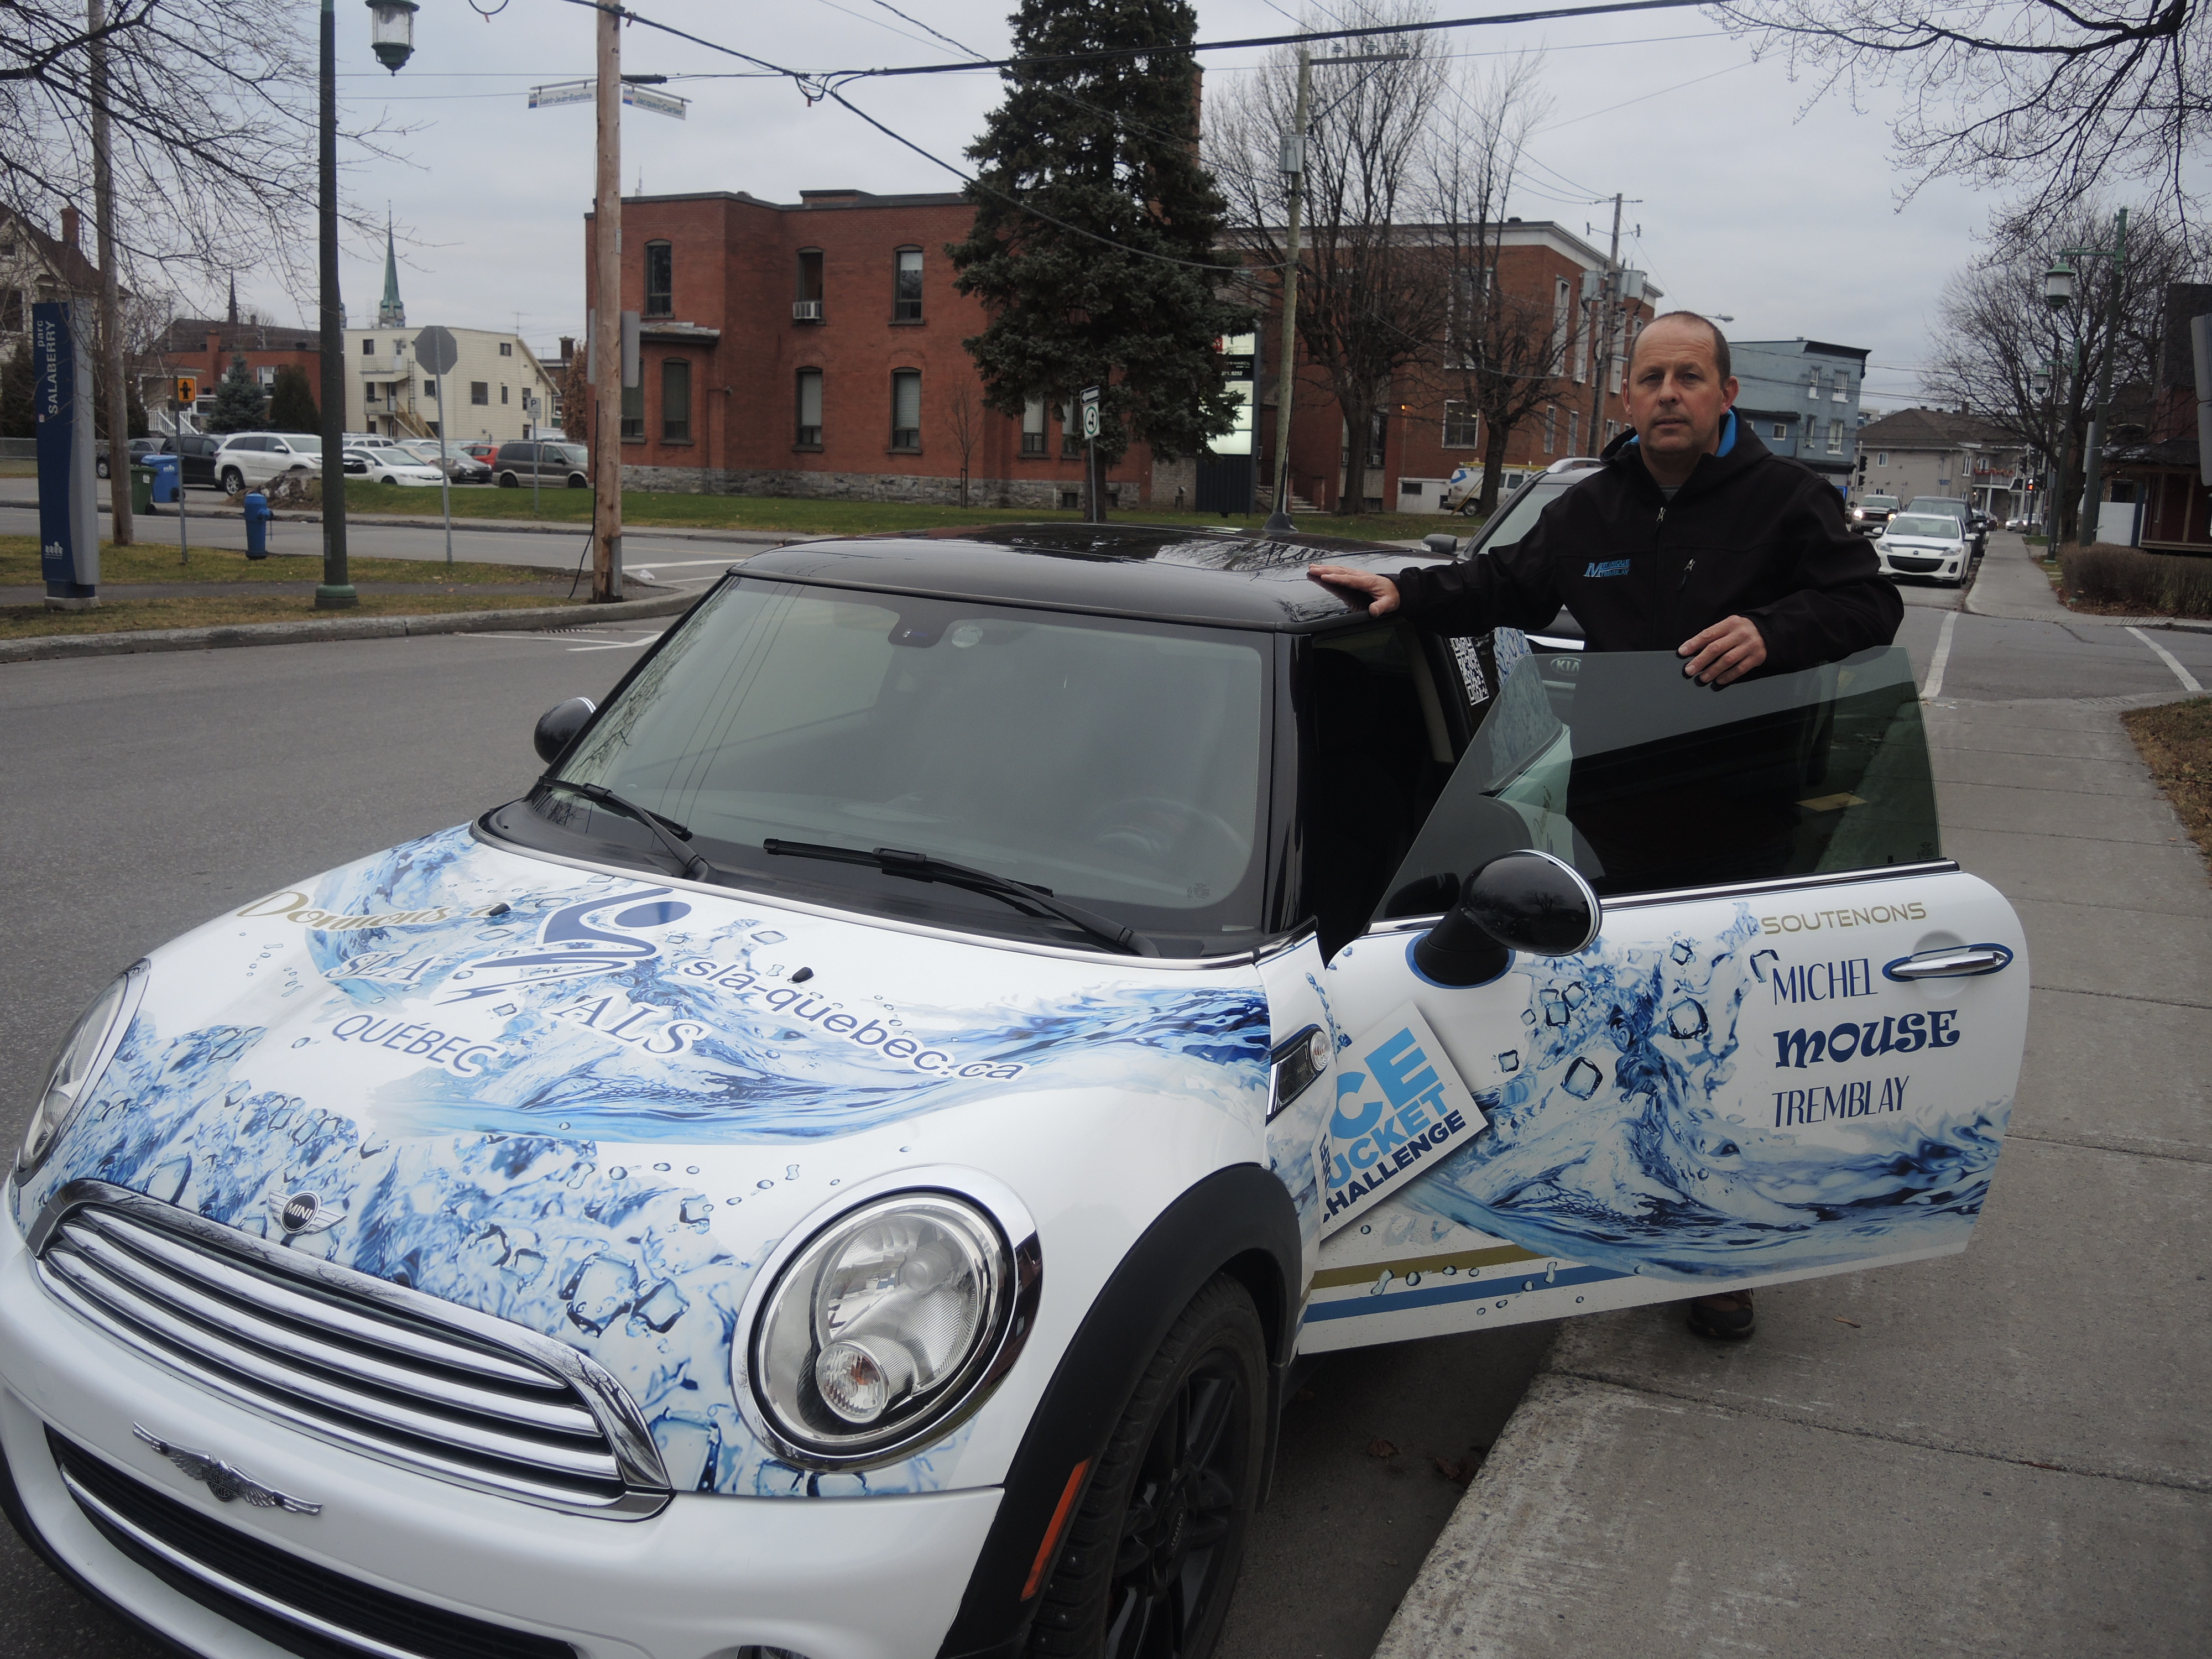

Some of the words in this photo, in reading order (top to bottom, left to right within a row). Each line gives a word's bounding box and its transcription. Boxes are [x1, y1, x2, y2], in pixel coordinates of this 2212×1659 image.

[635, 96, 683, 115] Jacques-Cartier
[37, 320, 46, 347] parc
[45, 320, 58, 415] SALABERRY
[1557, 660, 1580, 672] KIA
[237, 889, 452, 930] Donnons
[1761, 902, 1927, 935] SOUTENONS
[325, 952, 439, 981] SLA
[1772, 958, 1879, 1005] MICHEL
[331, 1014, 497, 1072] QUÉBEC
[552, 995, 704, 1053] ALS
[684, 959, 1024, 1080] sla-quebec.ca
[1329, 1027, 1439, 1139] CE
[1772, 1076, 1910, 1128] TREMBLAY
[1328, 1082, 1448, 1189] UCKET
[285, 1202, 314, 1220] MINI
